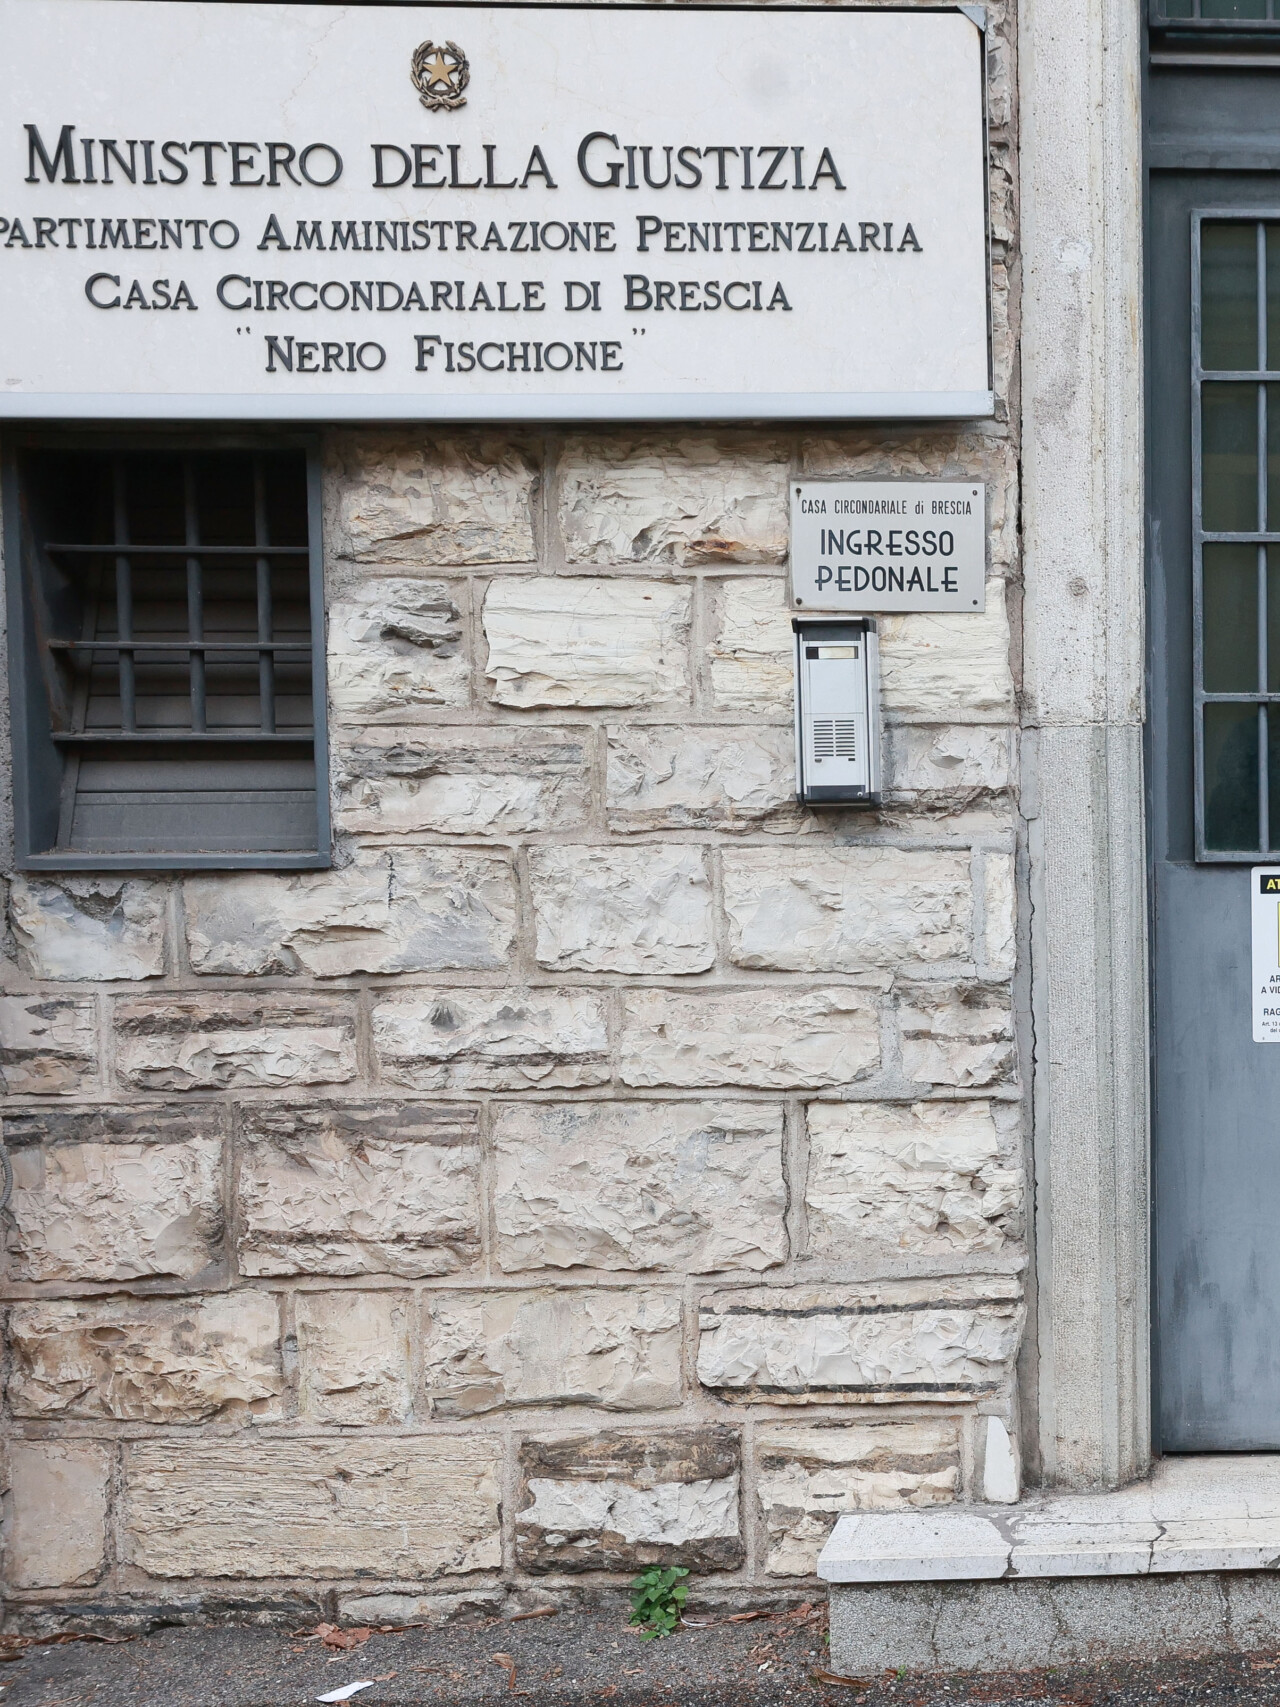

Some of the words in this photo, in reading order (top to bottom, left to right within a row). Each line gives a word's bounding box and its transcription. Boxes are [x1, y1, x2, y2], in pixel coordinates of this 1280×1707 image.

[23, 123, 344, 188] MINISTERO
[370, 143, 558, 190] DELLA
[577, 131, 847, 191] GIUSTIZIA
[256, 213, 617, 253] AMMINISTRAZIONE
[635, 215, 924, 253] PENITENZIARIA
[84, 272, 199, 311] CASA
[216, 273, 546, 312] CIRCONDARIALE
[563, 281, 602, 312] DI
[623, 274, 793, 312] BRESCIA
[801, 499, 827, 514] CASA
[834, 499, 907, 515] CIRCONDARIALE
[914, 500, 924, 515] di
[931, 500, 972, 516] BRESCIA
[821, 528, 954, 557] INGRESSO
[814, 565, 959, 593] PEDONALE
[1260, 986, 1267, 994] A
